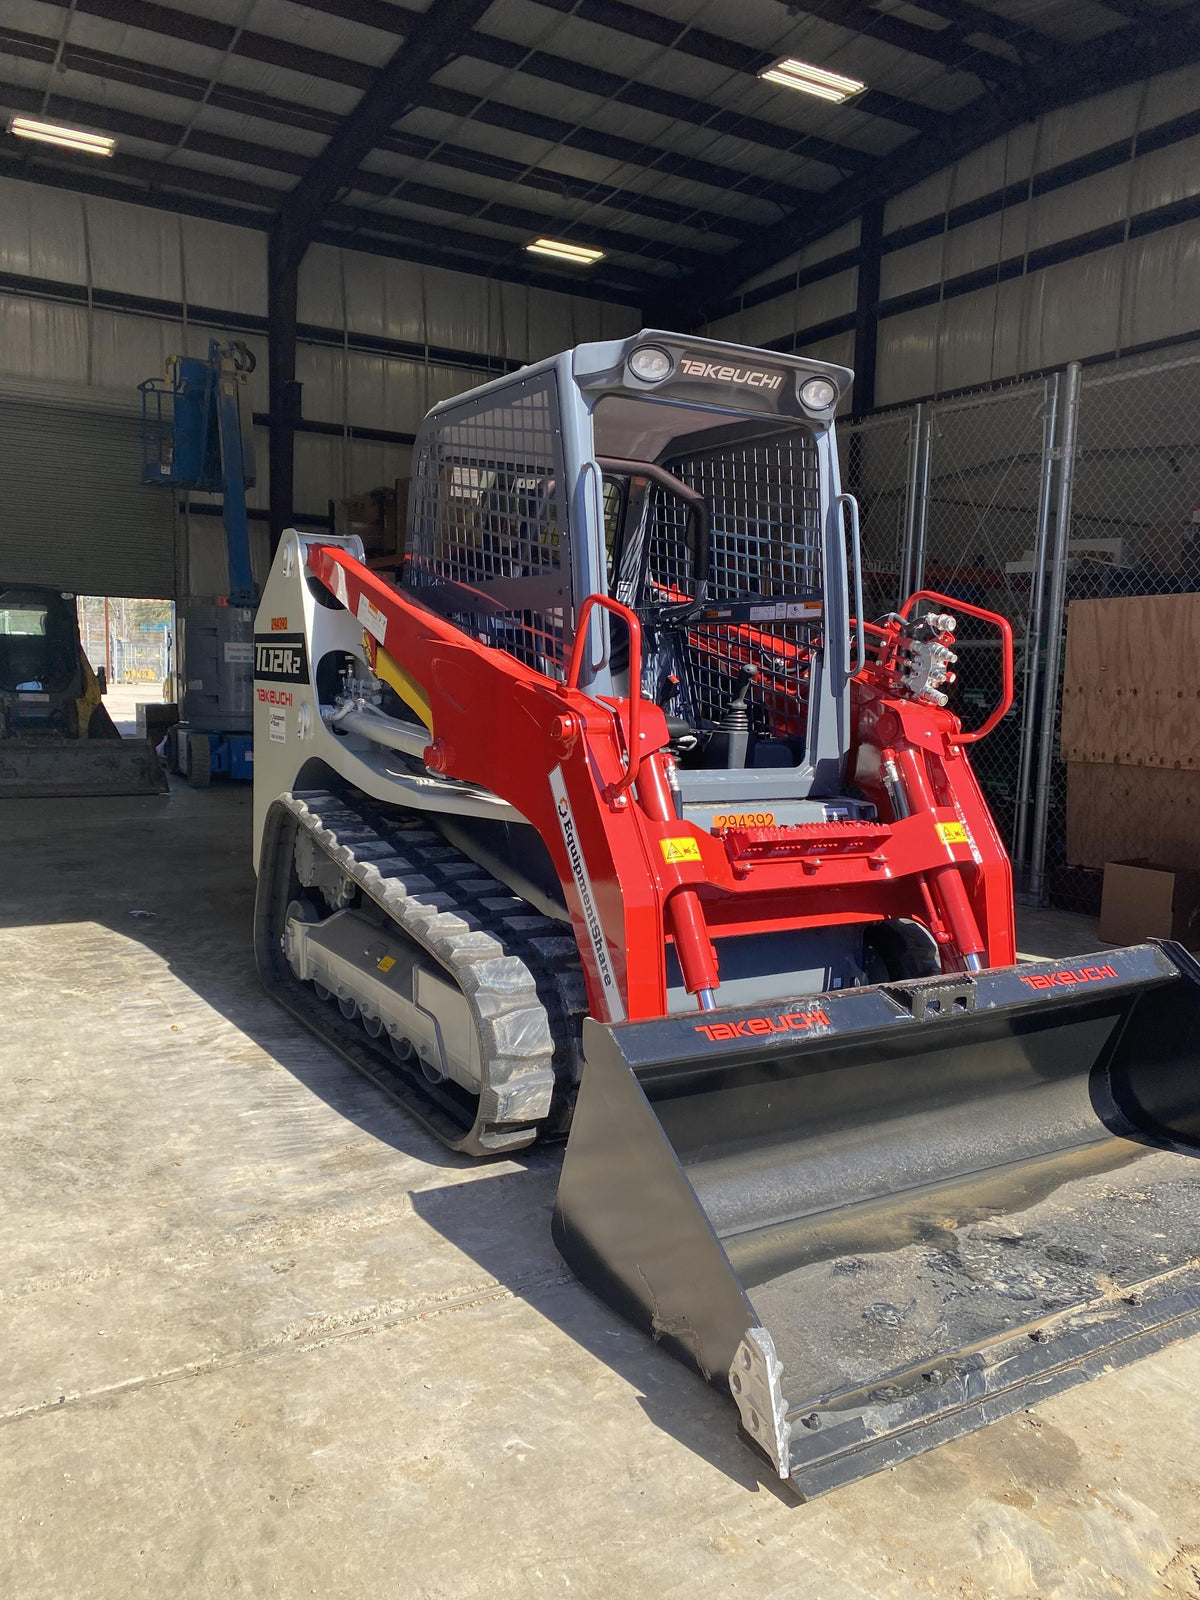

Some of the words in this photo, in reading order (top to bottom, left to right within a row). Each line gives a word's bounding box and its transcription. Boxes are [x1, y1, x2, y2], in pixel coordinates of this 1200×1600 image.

[681, 359, 782, 389] TAKEUCHI
[257, 688, 293, 707] TAKEUCHI
[719, 813, 774, 828] 294392
[563, 819, 612, 987] EquipmentShare
[1020, 965, 1118, 990] TAKEUCHI
[694, 1009, 831, 1042] TAKEUCHI
